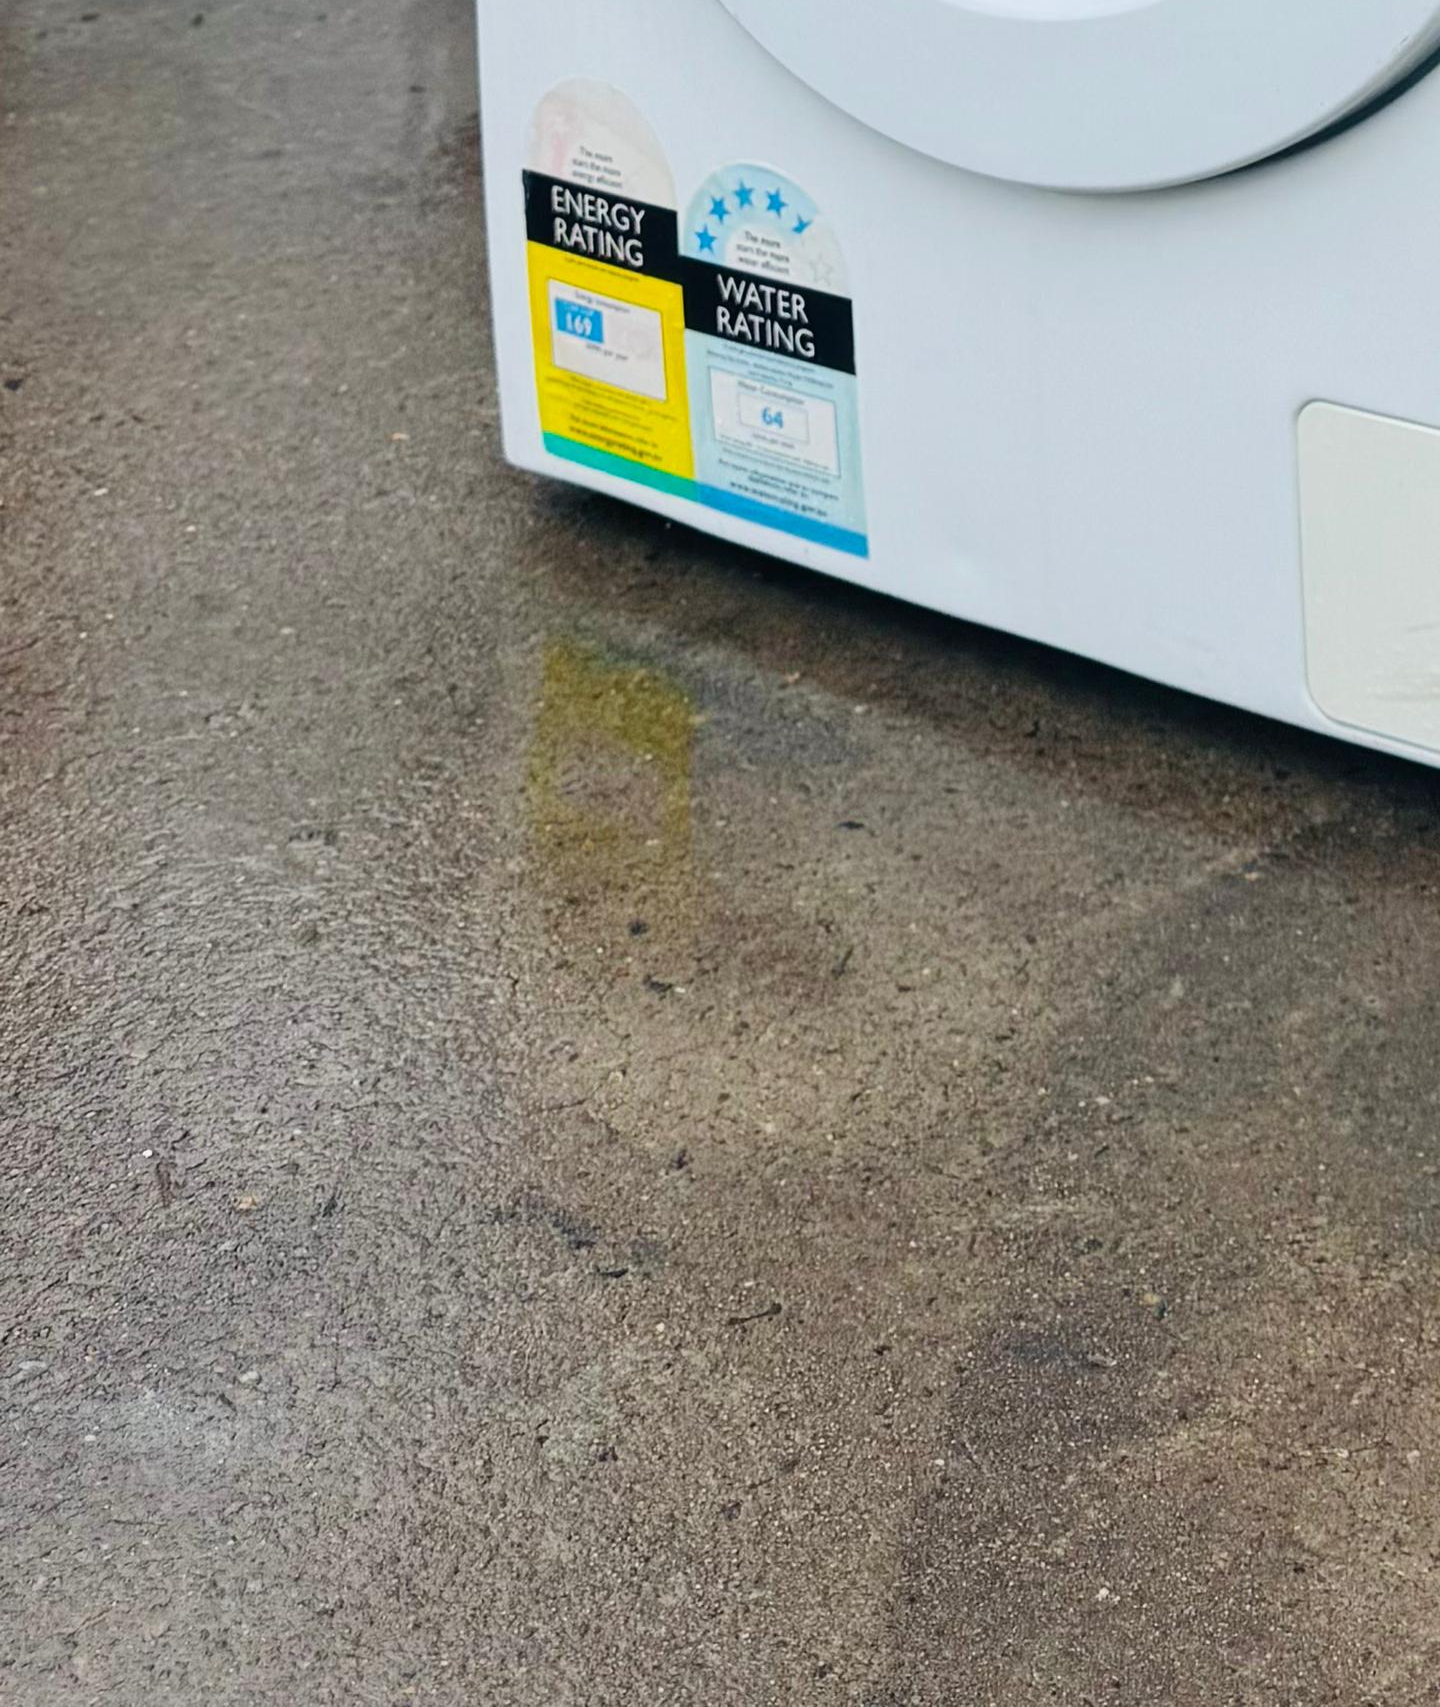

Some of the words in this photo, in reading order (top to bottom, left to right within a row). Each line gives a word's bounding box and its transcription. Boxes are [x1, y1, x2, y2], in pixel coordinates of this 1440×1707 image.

[551, 185, 645, 235] ENERGY
[553, 217, 644, 267] RATING
[716, 273, 809, 324] WATER
[565, 312, 593, 337] 169
[716, 305, 816, 358] RATING
[762, 405, 784, 429] 64
